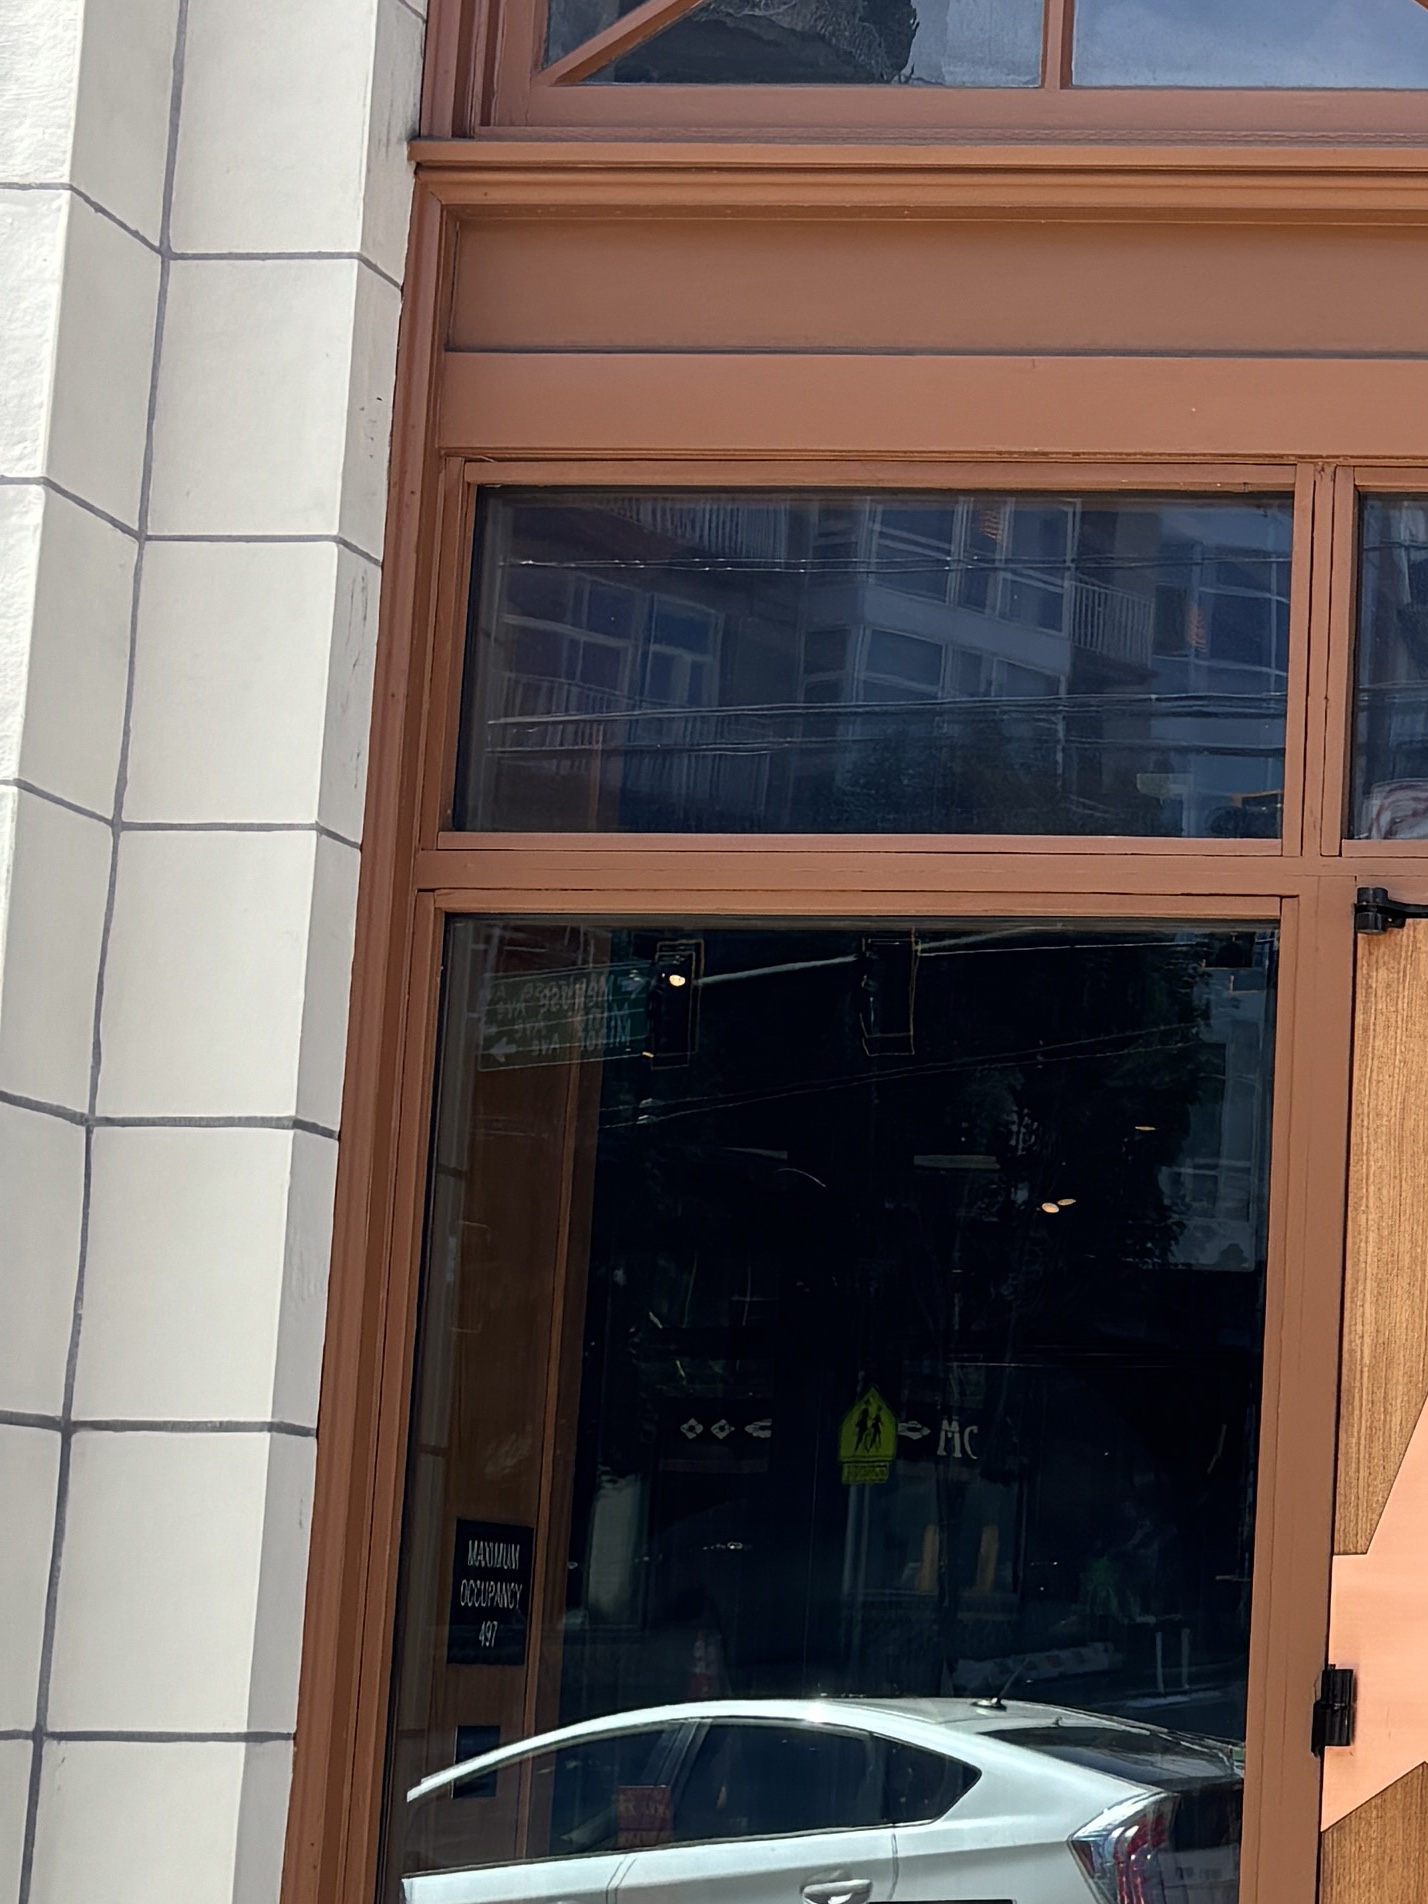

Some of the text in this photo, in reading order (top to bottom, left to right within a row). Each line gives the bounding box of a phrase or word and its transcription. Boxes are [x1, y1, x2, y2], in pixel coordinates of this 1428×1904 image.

[468, 1540, 520, 1569] MAXIMUM
[460, 1579, 522, 1610] OCCUPANCY
[478, 1620, 498, 1647] 497
